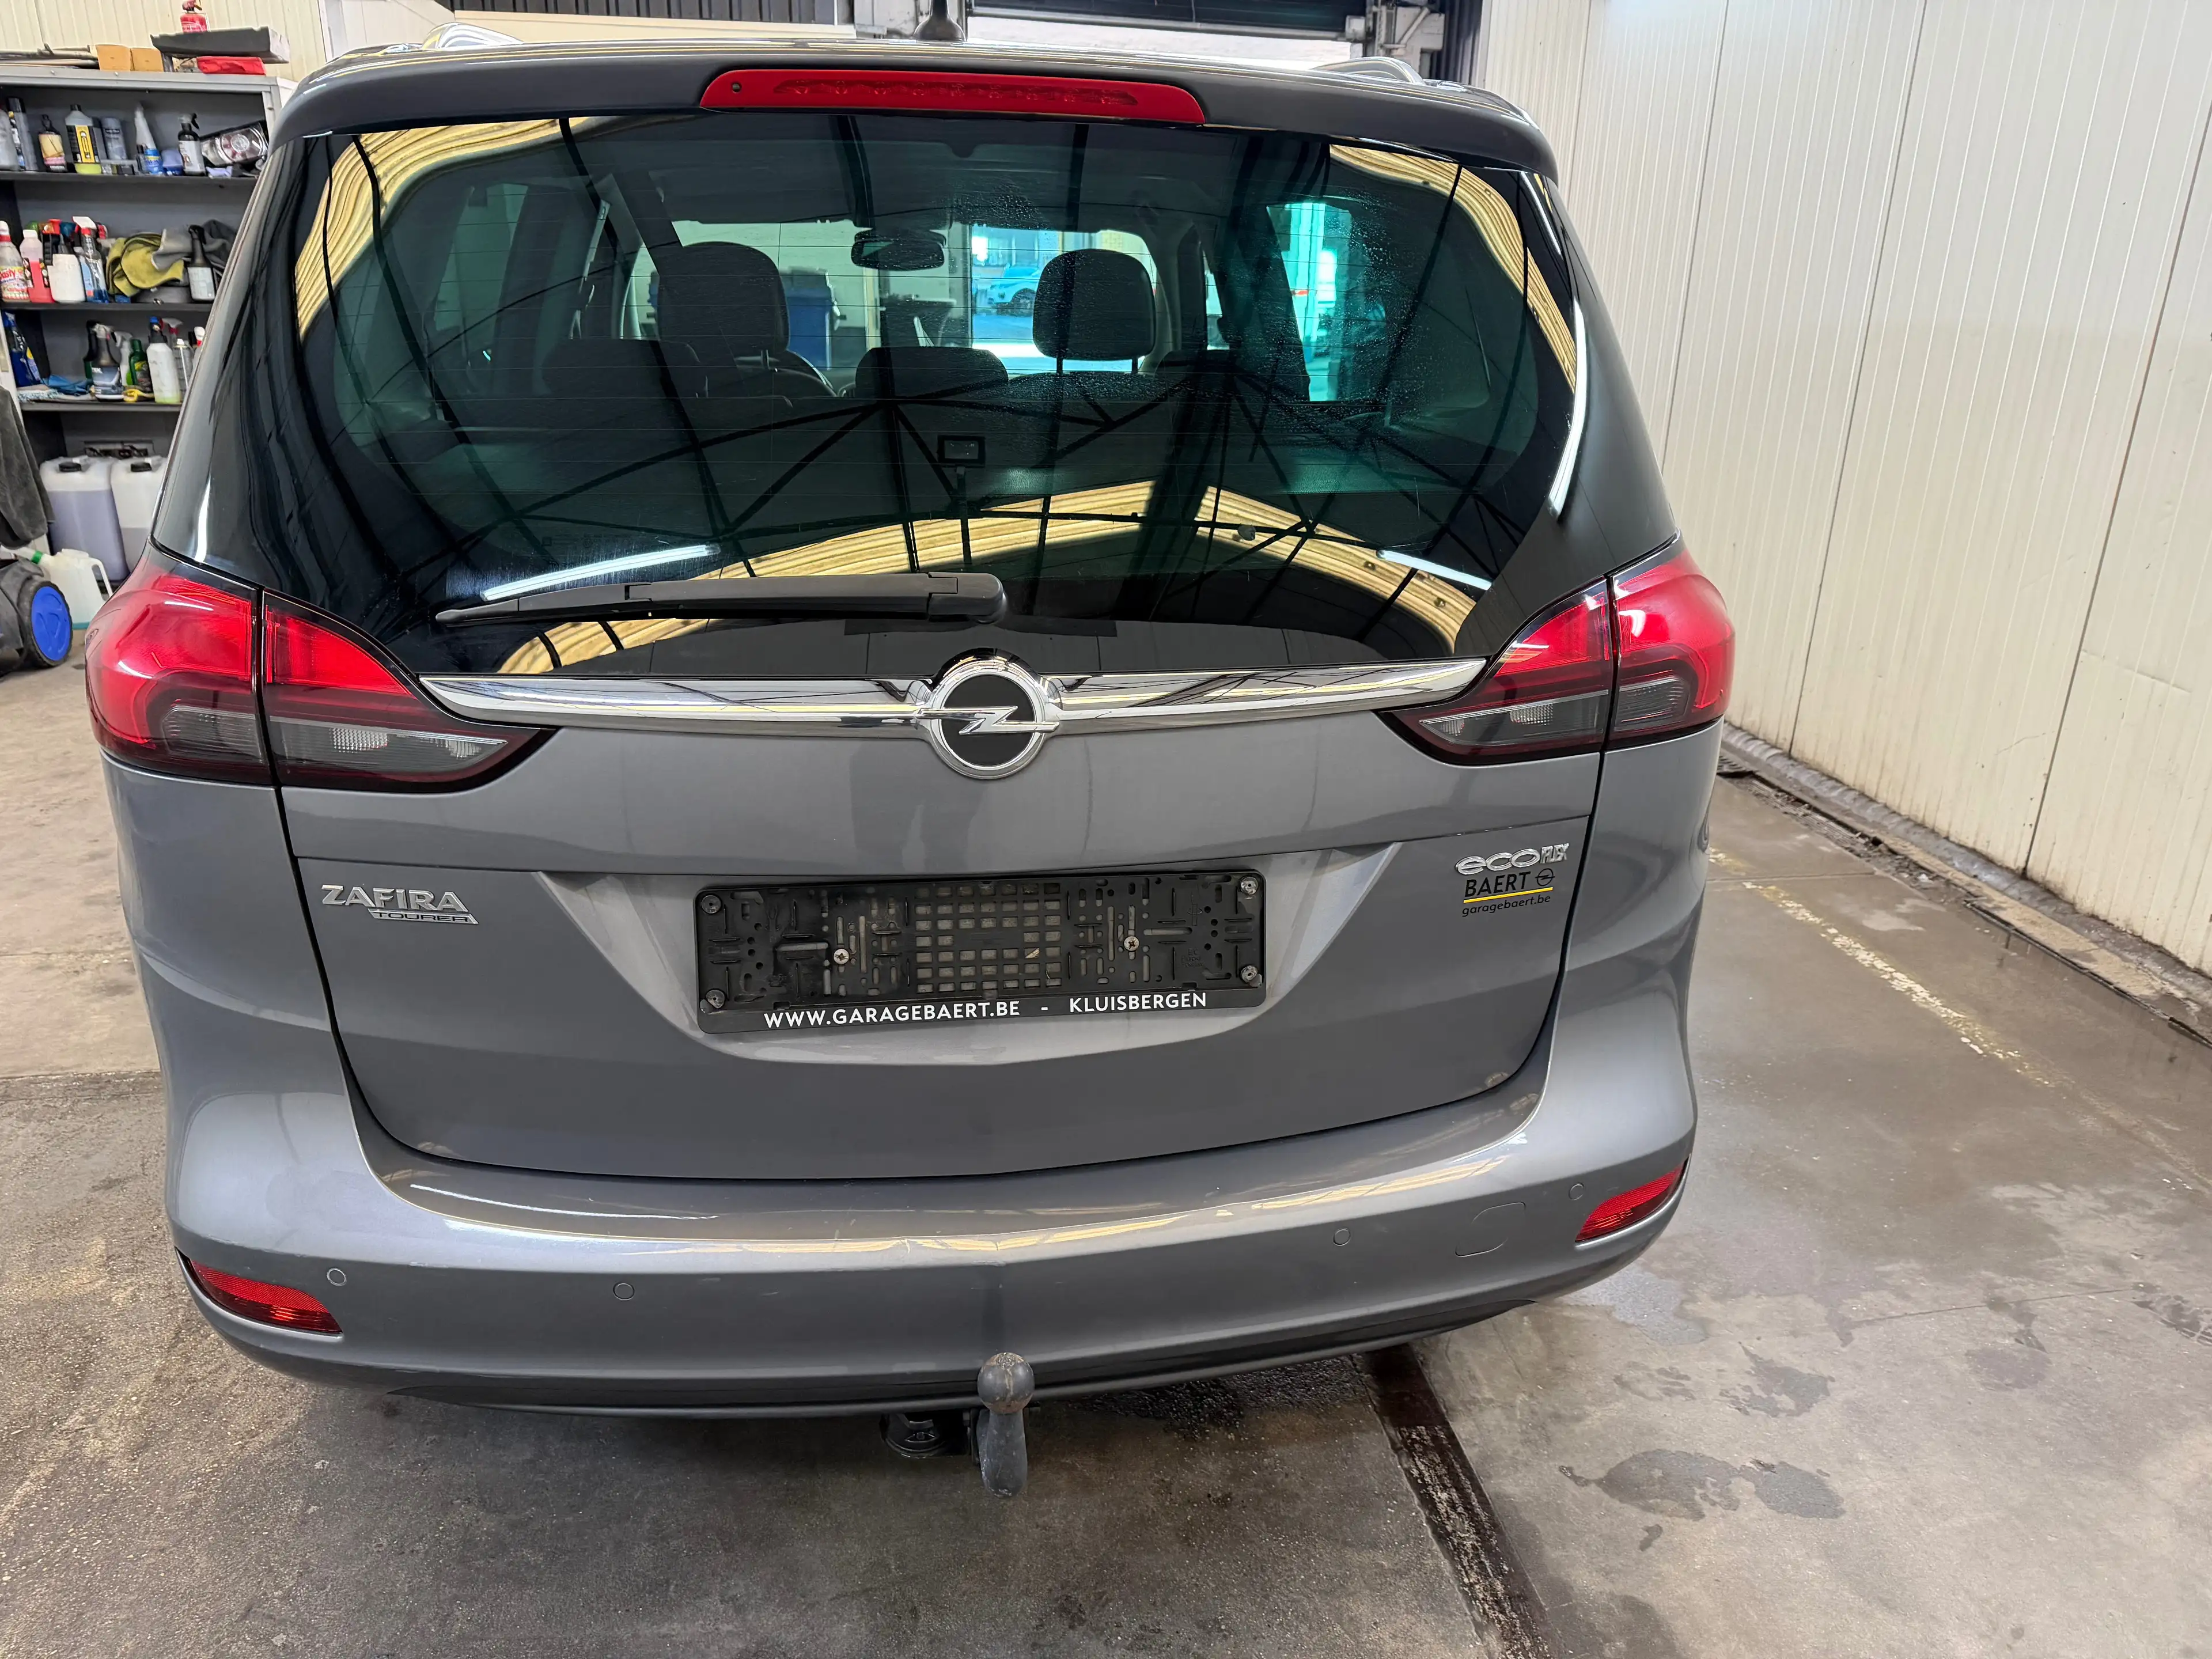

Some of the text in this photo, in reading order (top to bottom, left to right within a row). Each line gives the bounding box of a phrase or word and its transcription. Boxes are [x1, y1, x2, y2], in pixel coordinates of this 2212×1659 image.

[1464, 871, 1531, 897] BAERT
[321, 884, 469, 912] ZAFIRA
[1461, 894, 1551, 917] garagebaert.be
[377, 911, 468, 922] TOURER
[763, 1001, 1020, 1028] WWW.GARAGEBAERT.BE
[1070, 992, 1206, 1013] KLUISBERGEN
